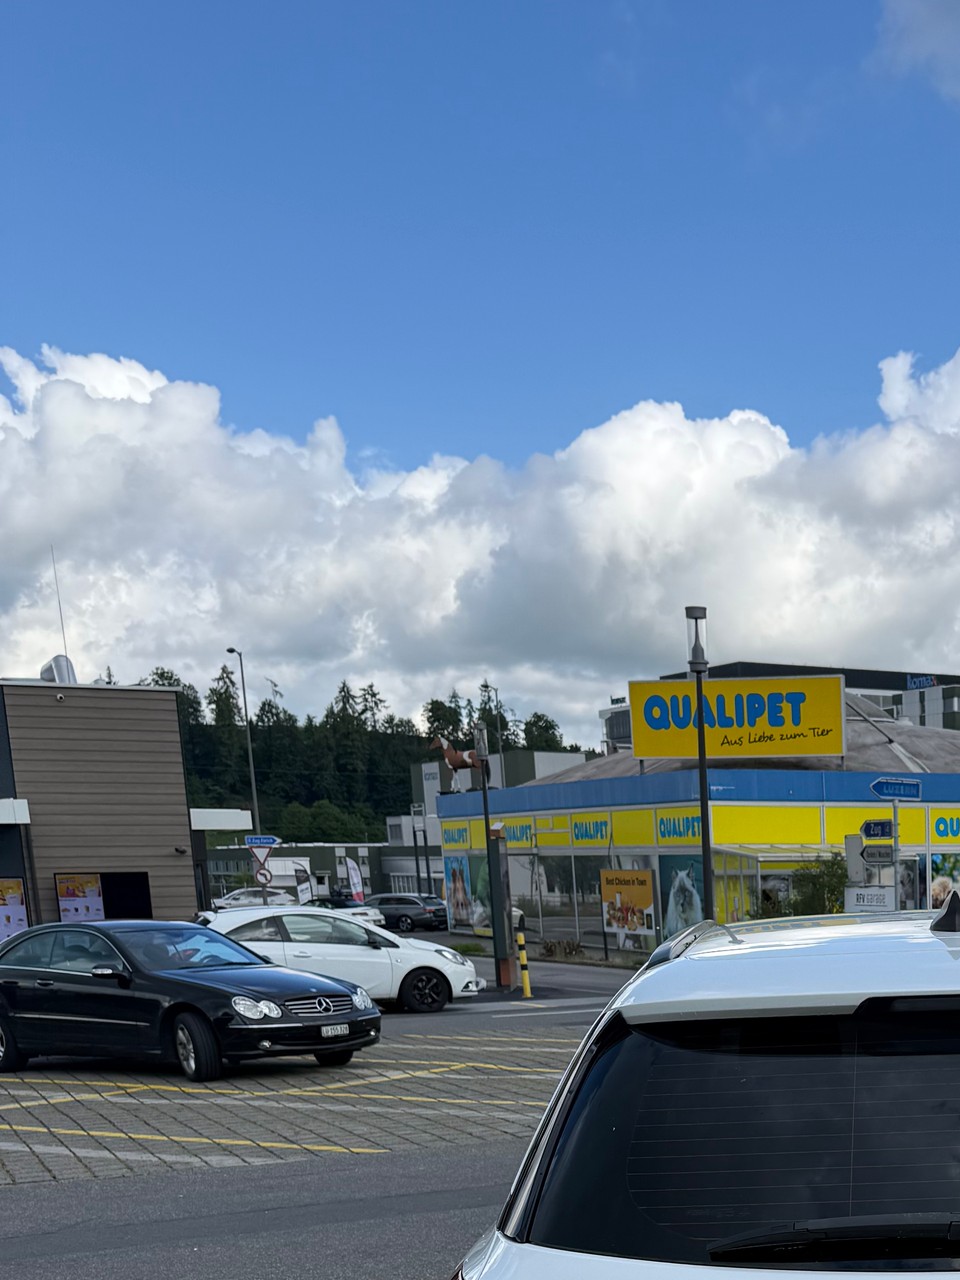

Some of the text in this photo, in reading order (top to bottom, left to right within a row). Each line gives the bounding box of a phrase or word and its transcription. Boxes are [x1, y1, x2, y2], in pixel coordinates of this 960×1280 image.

[644, 692, 806, 730] QUALIPET
[721, 727, 832, 747] Aus Liebe zum Tier
[573, 821, 608, 840] QUALIPET
[870, 823, 881, 836] Zug
[606, 877, 614, 886] Best
[615, 877, 630, 886] Chicken
[636, 877, 647, 886] Town
